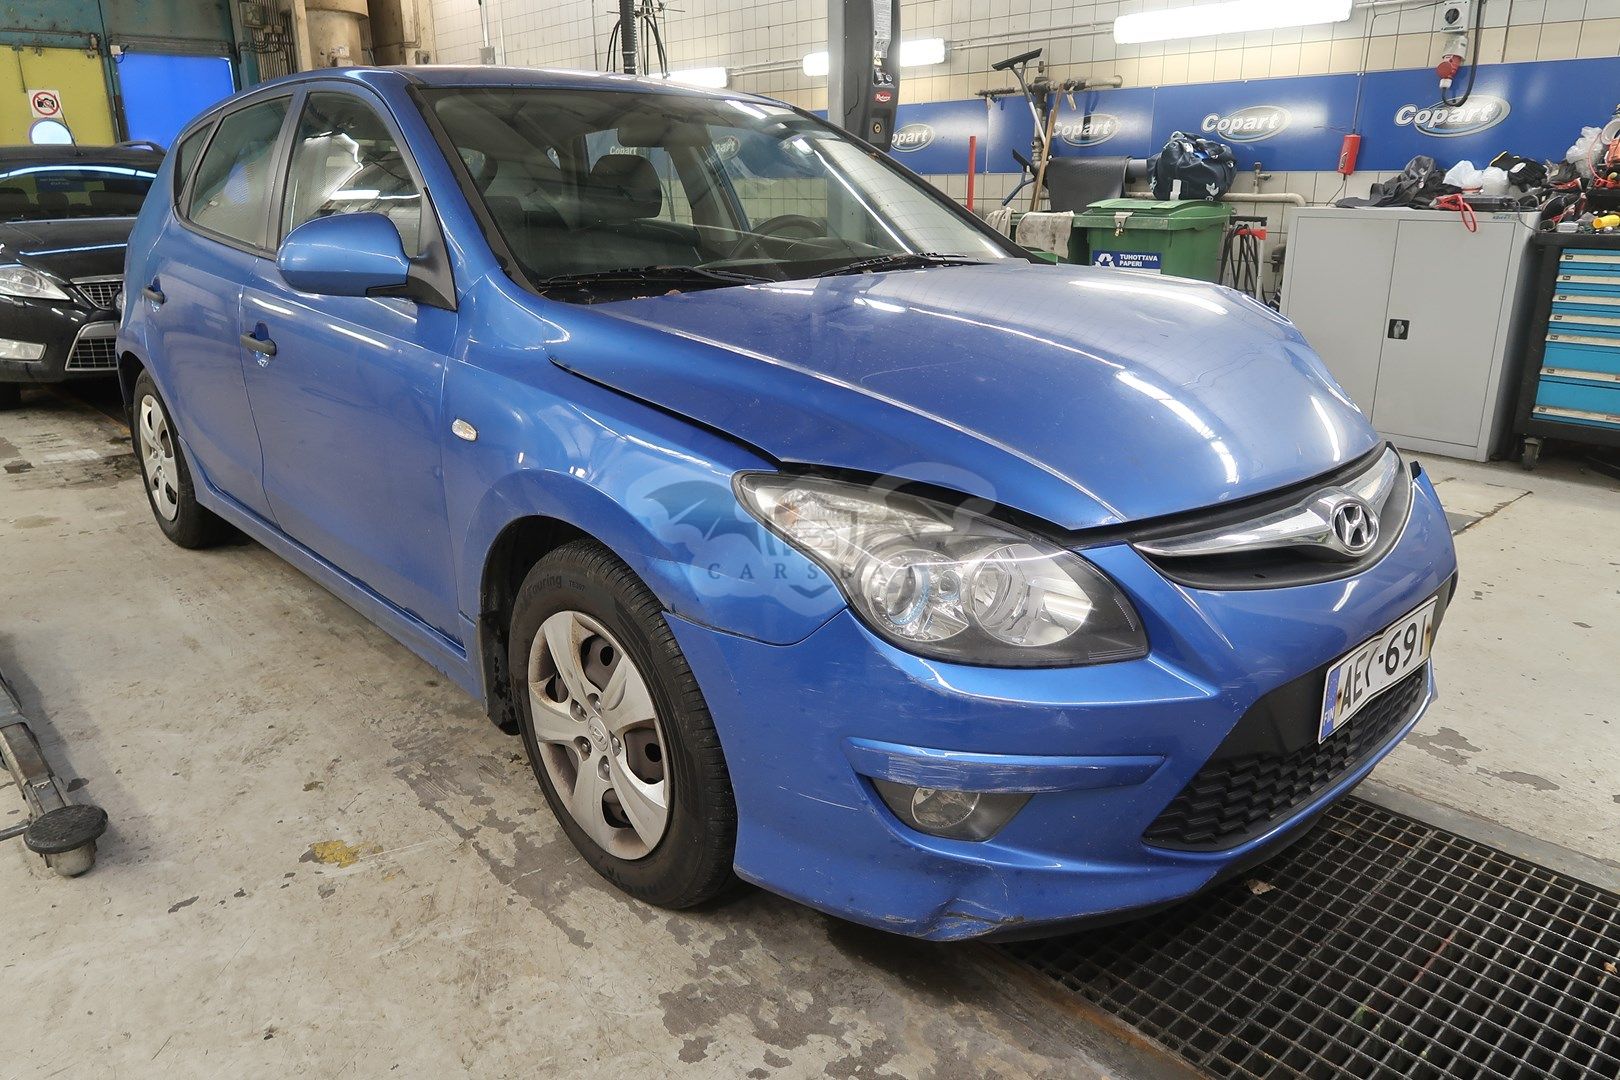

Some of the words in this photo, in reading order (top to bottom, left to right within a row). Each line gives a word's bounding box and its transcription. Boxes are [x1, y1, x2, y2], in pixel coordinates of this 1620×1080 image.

[1203, 113, 1279, 134] Copart
[1396, 103, 1497, 128] Copart
[892, 130, 928, 145] opart
[1052, 121, 1112, 140] Copart
[1119, 254, 1158, 262] TUHOTTAVA
